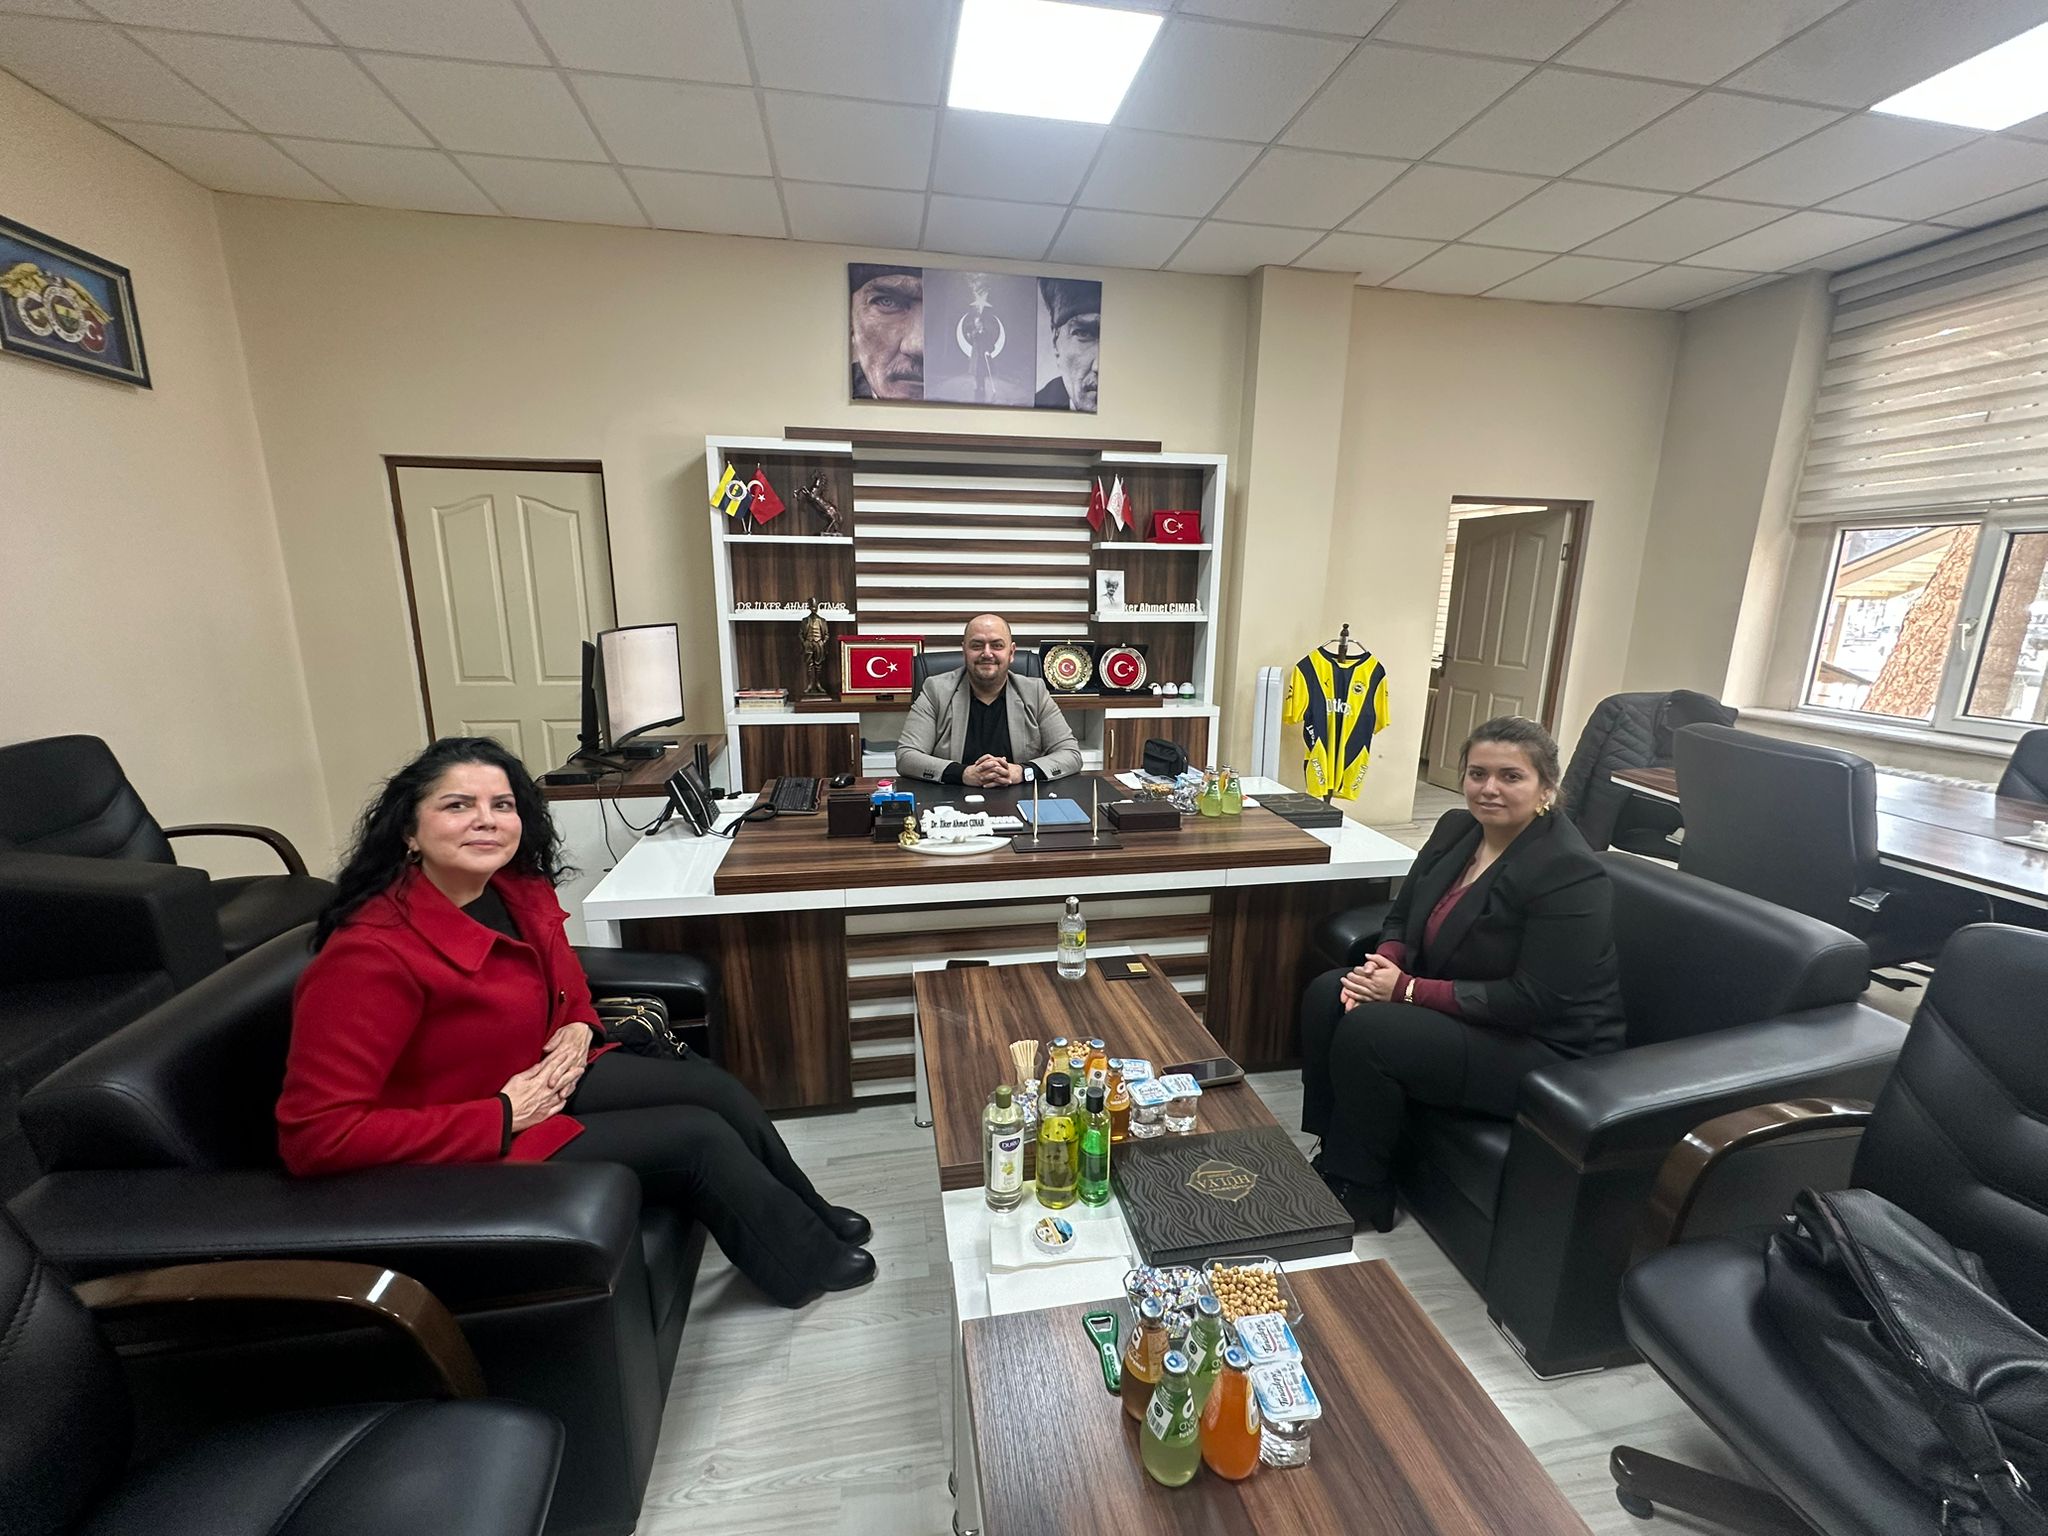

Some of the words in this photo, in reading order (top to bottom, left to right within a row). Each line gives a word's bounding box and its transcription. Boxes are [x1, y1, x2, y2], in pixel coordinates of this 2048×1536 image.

[783, 601, 809, 611] AHME
[1140, 603, 1168, 613] Ahmet
[953, 819, 969, 828] Ahmet
